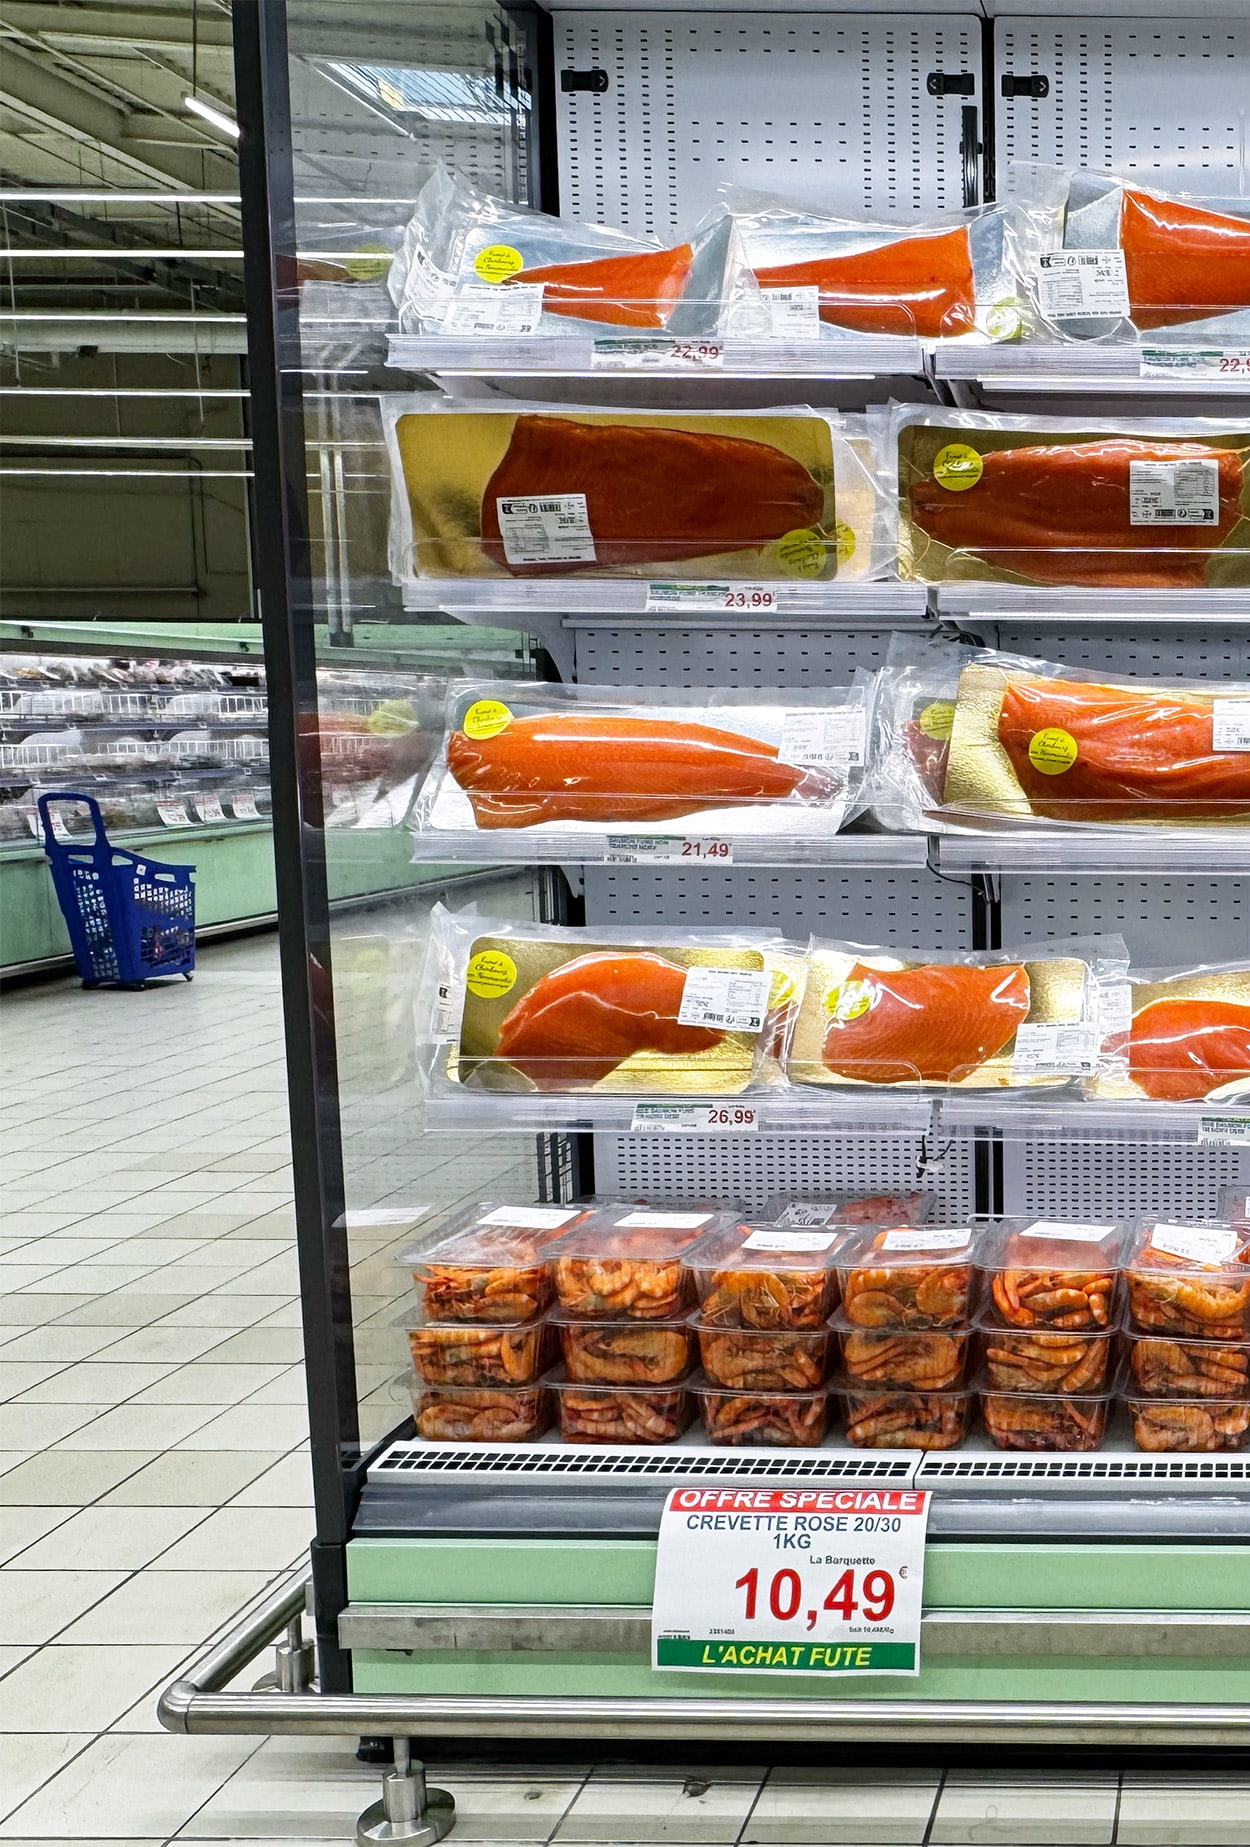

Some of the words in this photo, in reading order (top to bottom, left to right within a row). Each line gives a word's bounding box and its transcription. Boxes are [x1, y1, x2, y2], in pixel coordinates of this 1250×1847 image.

[725, 592, 773, 609] 23,99
[681, 841, 729, 859] 21,49
[707, 1109, 754, 1126] 26,99
[680, 1489, 772, 1509] OFFRE
[779, 1490, 918, 1511] SPECIALE
[686, 1513, 789, 1532] CREVETTE
[793, 1515, 848, 1532] ROSE
[852, 1516, 902, 1533] 20/30
[772, 1533, 812, 1550] 1KG
[809, 1554, 823, 1565] La
[734, 1567, 896, 1632] 10,49
[701, 1644, 805, 1666] L'ACHAT
[808, 1646, 873, 1667] FUTE
